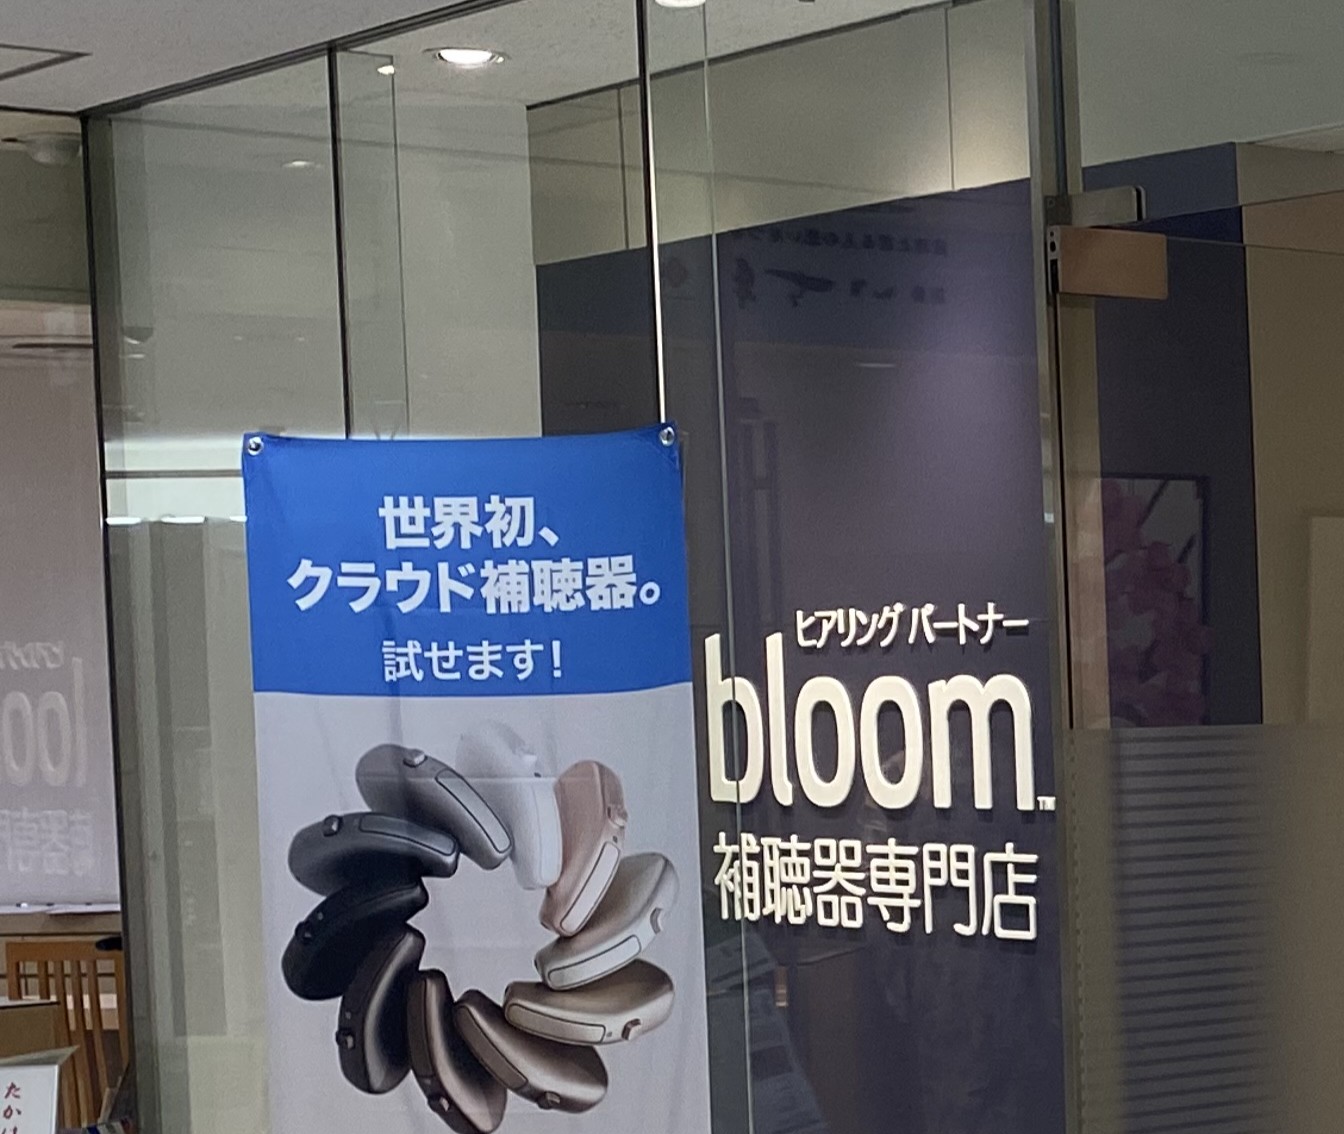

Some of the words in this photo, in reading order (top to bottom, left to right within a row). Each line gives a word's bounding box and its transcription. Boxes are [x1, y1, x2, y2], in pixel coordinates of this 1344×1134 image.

[378, 494, 560, 550] 世界初、
[287, 555, 661, 614] クラウド補聴器。
[713, 831, 1039, 941] 補聴器専門店
